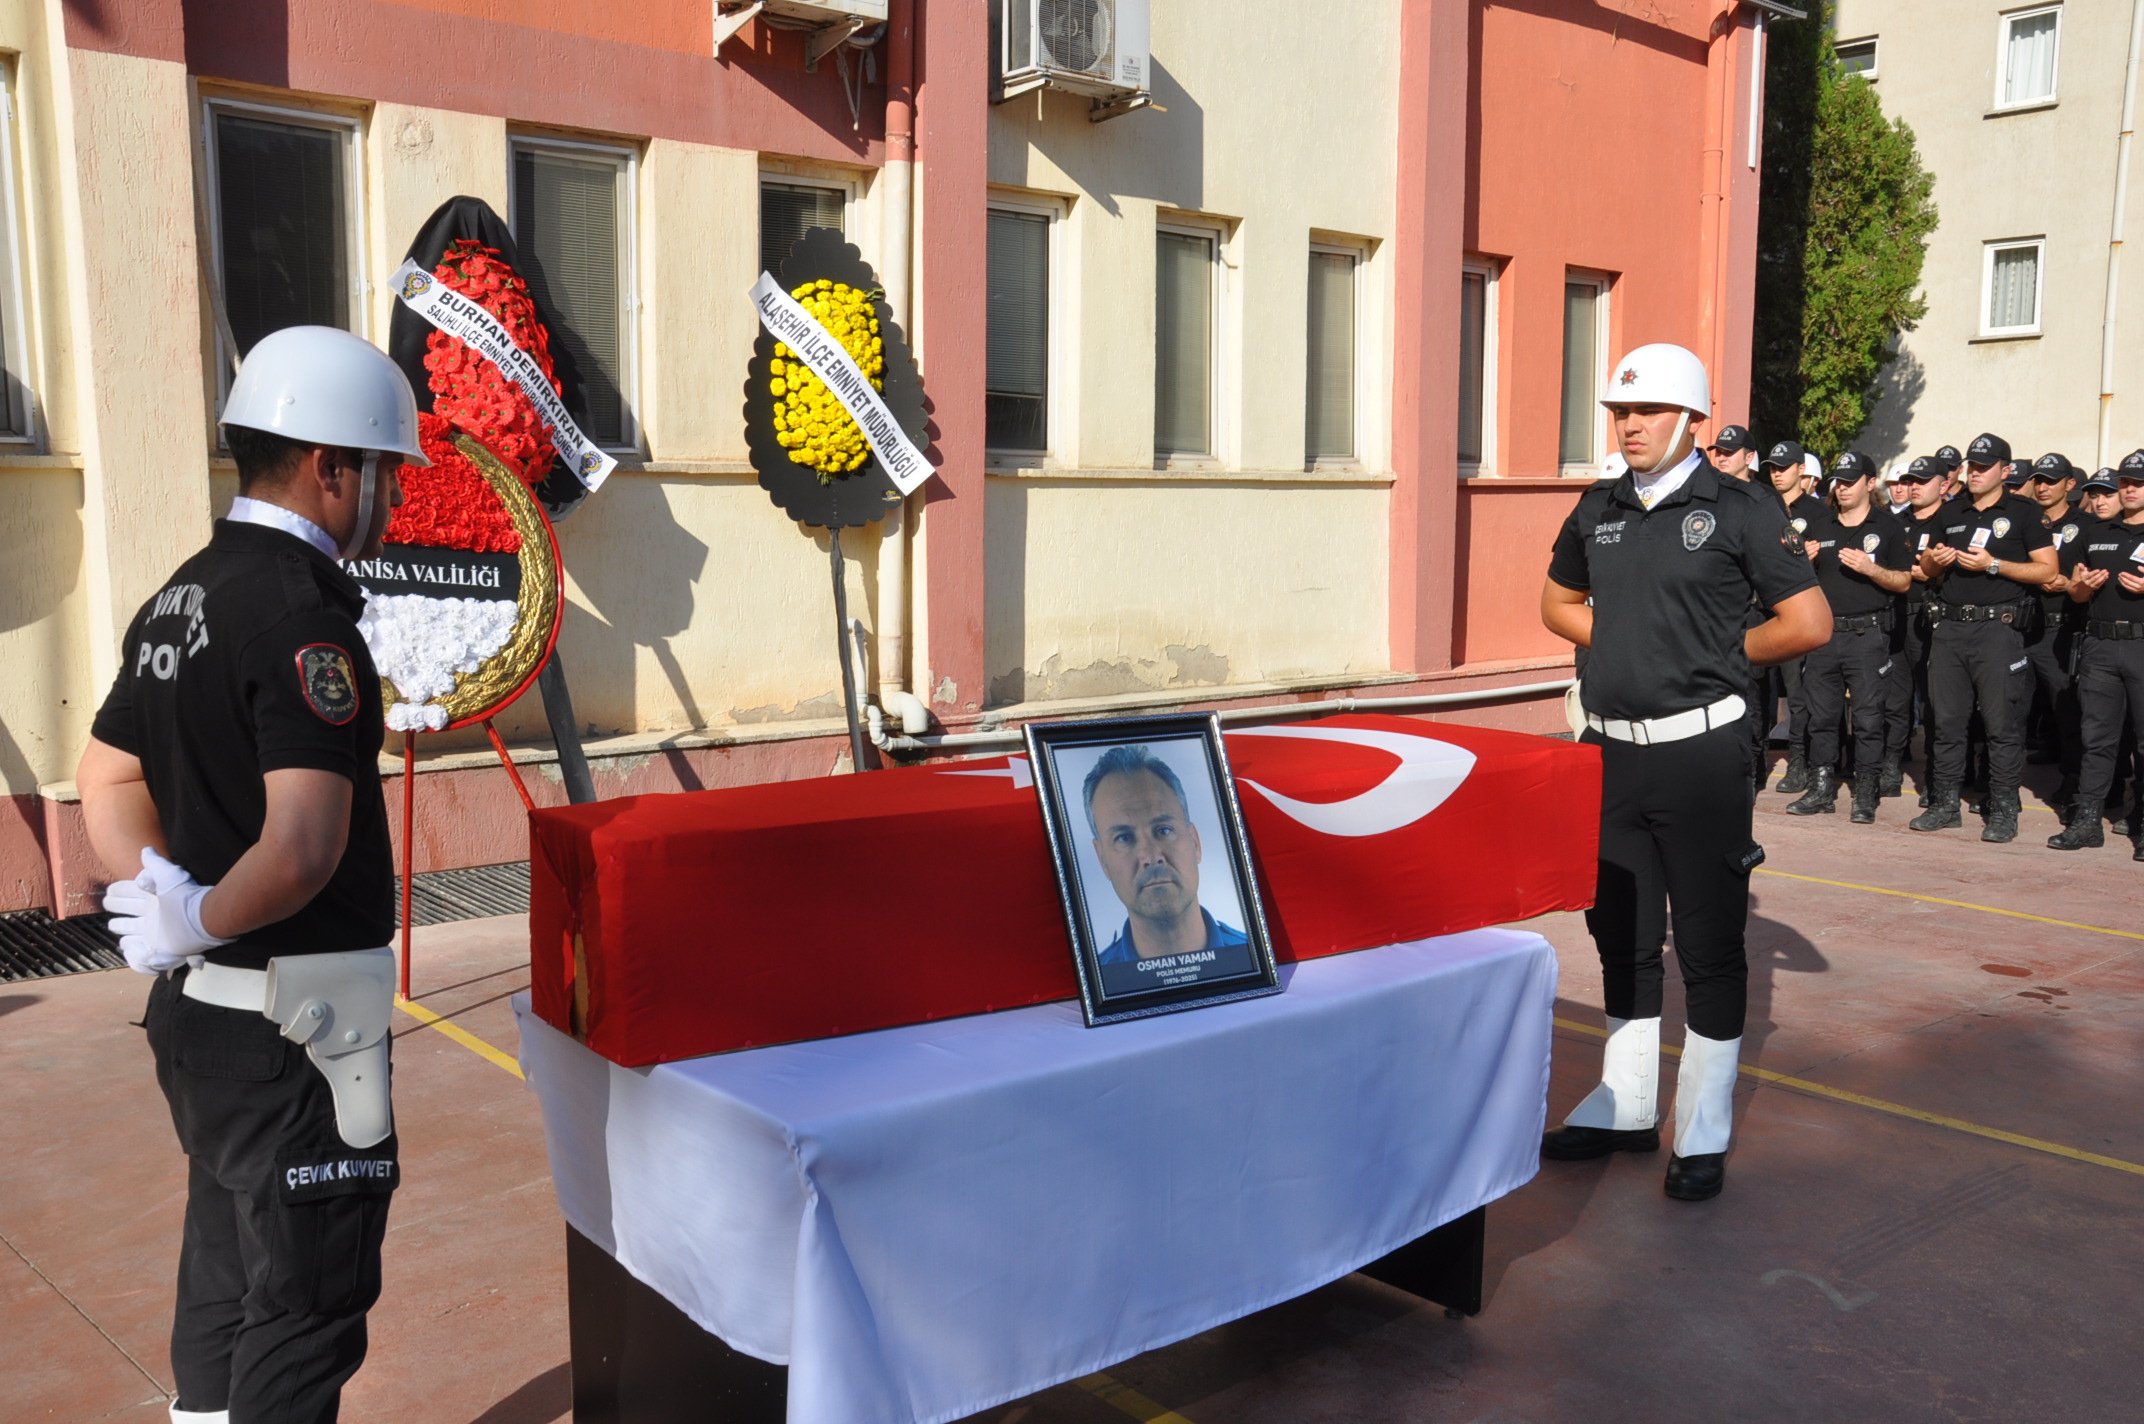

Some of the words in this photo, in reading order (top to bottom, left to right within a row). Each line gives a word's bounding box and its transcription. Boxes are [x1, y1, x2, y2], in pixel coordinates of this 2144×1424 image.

[427, 304, 461, 331] SALİHLİ
[460, 325, 483, 347] İLÇE
[478, 338, 516, 376] EMNİYET
[537, 402, 551, 420] VE
[438, 291, 511, 349] BURHAN
[510, 347, 585, 450] DEMİRKIRAN
[758, 291, 811, 345] ALAŞEHİR
[802, 331, 835, 367] İLÇE
[824, 358, 872, 413] EMNİYET
[861, 406, 921, 480] MÜDÜRLÜĞÜ
[1595, 532, 1621, 544] POLİS
[411, 563, 501, 588] VALİLİĞİ
[1136, 956, 1177, 972] OSMAN
[1177, 950, 1216, 965] YAMAN
[1156, 968, 1175, 977] POLİS
[1174, 964, 1202, 975] MEMURU
[286, 1162, 335, 1190] ÇEVİK
[338, 1159, 393, 1179] KUVVET
